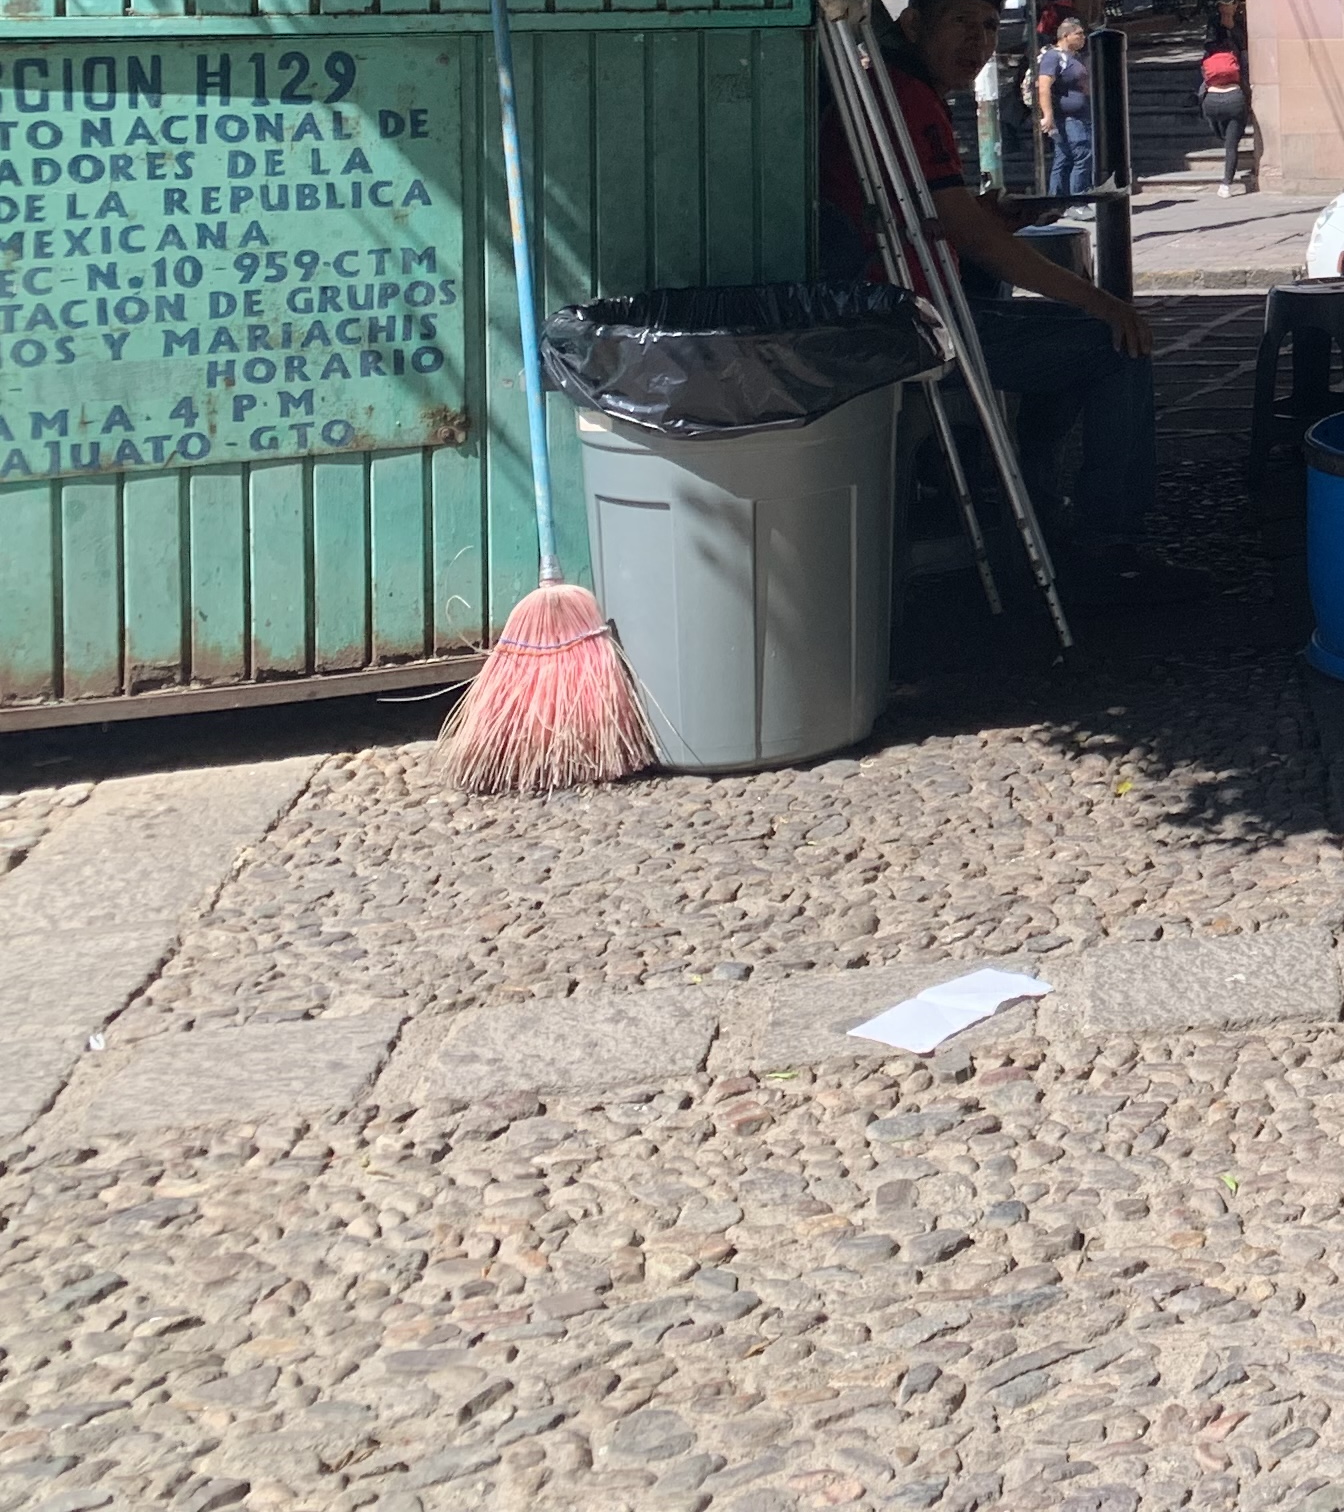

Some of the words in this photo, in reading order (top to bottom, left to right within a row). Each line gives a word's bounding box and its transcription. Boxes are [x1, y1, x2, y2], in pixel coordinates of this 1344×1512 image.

[0, 54, 163, 114] CION
[195, 51, 357, 109] H129
[80, 110, 354, 149] NACIONAL
[379, 109, 430, 139] DE
[227, 149, 286, 180] DE
[311, 147, 374, 175] LA
[66, 191, 128, 221] LA
[163, 179, 433, 216] REPUBLICA
[209, 289, 265, 320] DE
[286, 279, 457, 314] GRUPOS
[102, 331, 131, 361] Y
[162, 313, 438, 357] MARIACHIS
[206, 346, 446, 388] HORARIO
[169, 396, 200, 429] 4
